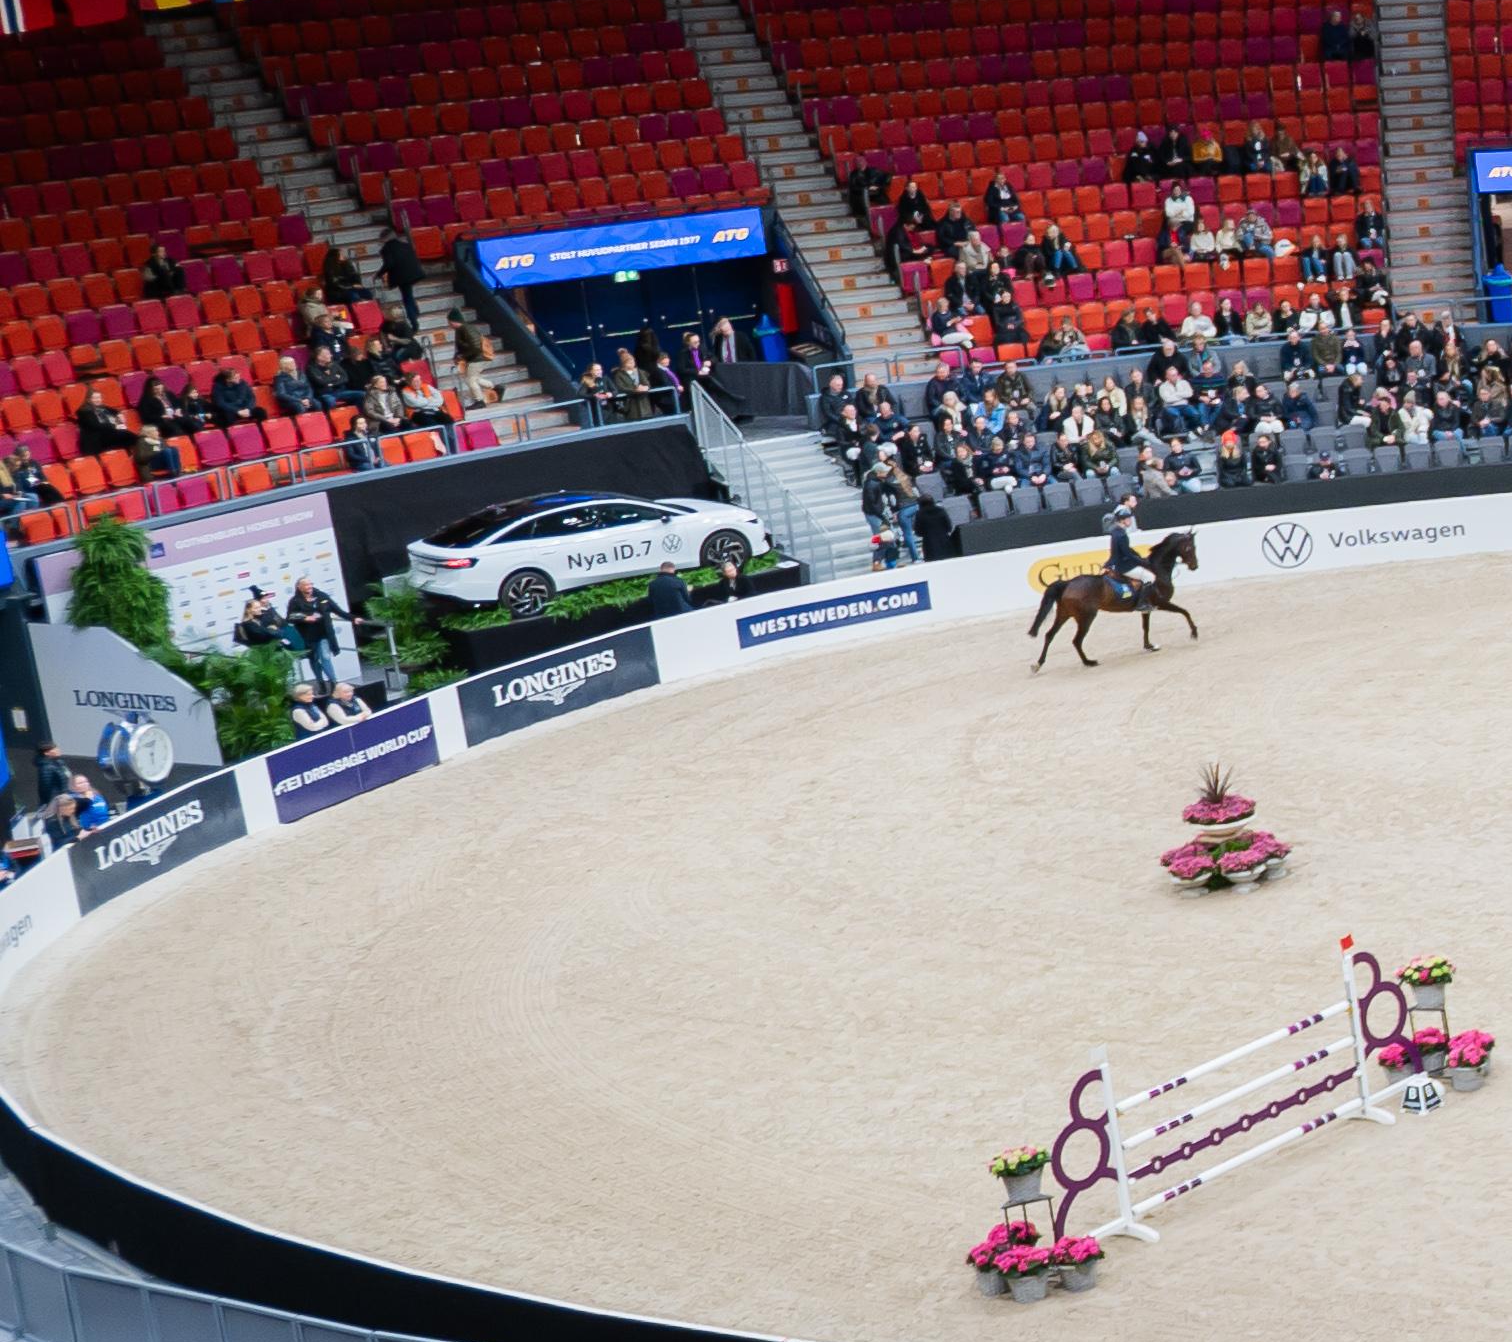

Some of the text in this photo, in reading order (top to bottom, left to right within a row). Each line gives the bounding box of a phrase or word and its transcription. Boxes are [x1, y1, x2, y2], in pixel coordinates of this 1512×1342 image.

[494, 253, 536, 271] ATG
[549, 250, 577, 262] STOLT
[712, 227, 750, 244] ATG
[175, 526, 246, 551] GOTHENBURG
[246, 517, 282, 533] HORSE
[283, 510, 314, 526] SHOW
[1328, 521, 1465, 548] Volkswagen
[566, 539, 653, 573] Nya ID.7
[749, 590, 919, 640] WESTSWEDEN.COM
[492, 648, 618, 709] LONGINES
[73, 689, 178, 715] LONGINES
[304, 750, 368, 785] DRESSAGE
[367, 734, 408, 761] WORLD
[407, 724, 433, 744] CUP
[95, 799, 205, 871] LONGINES
